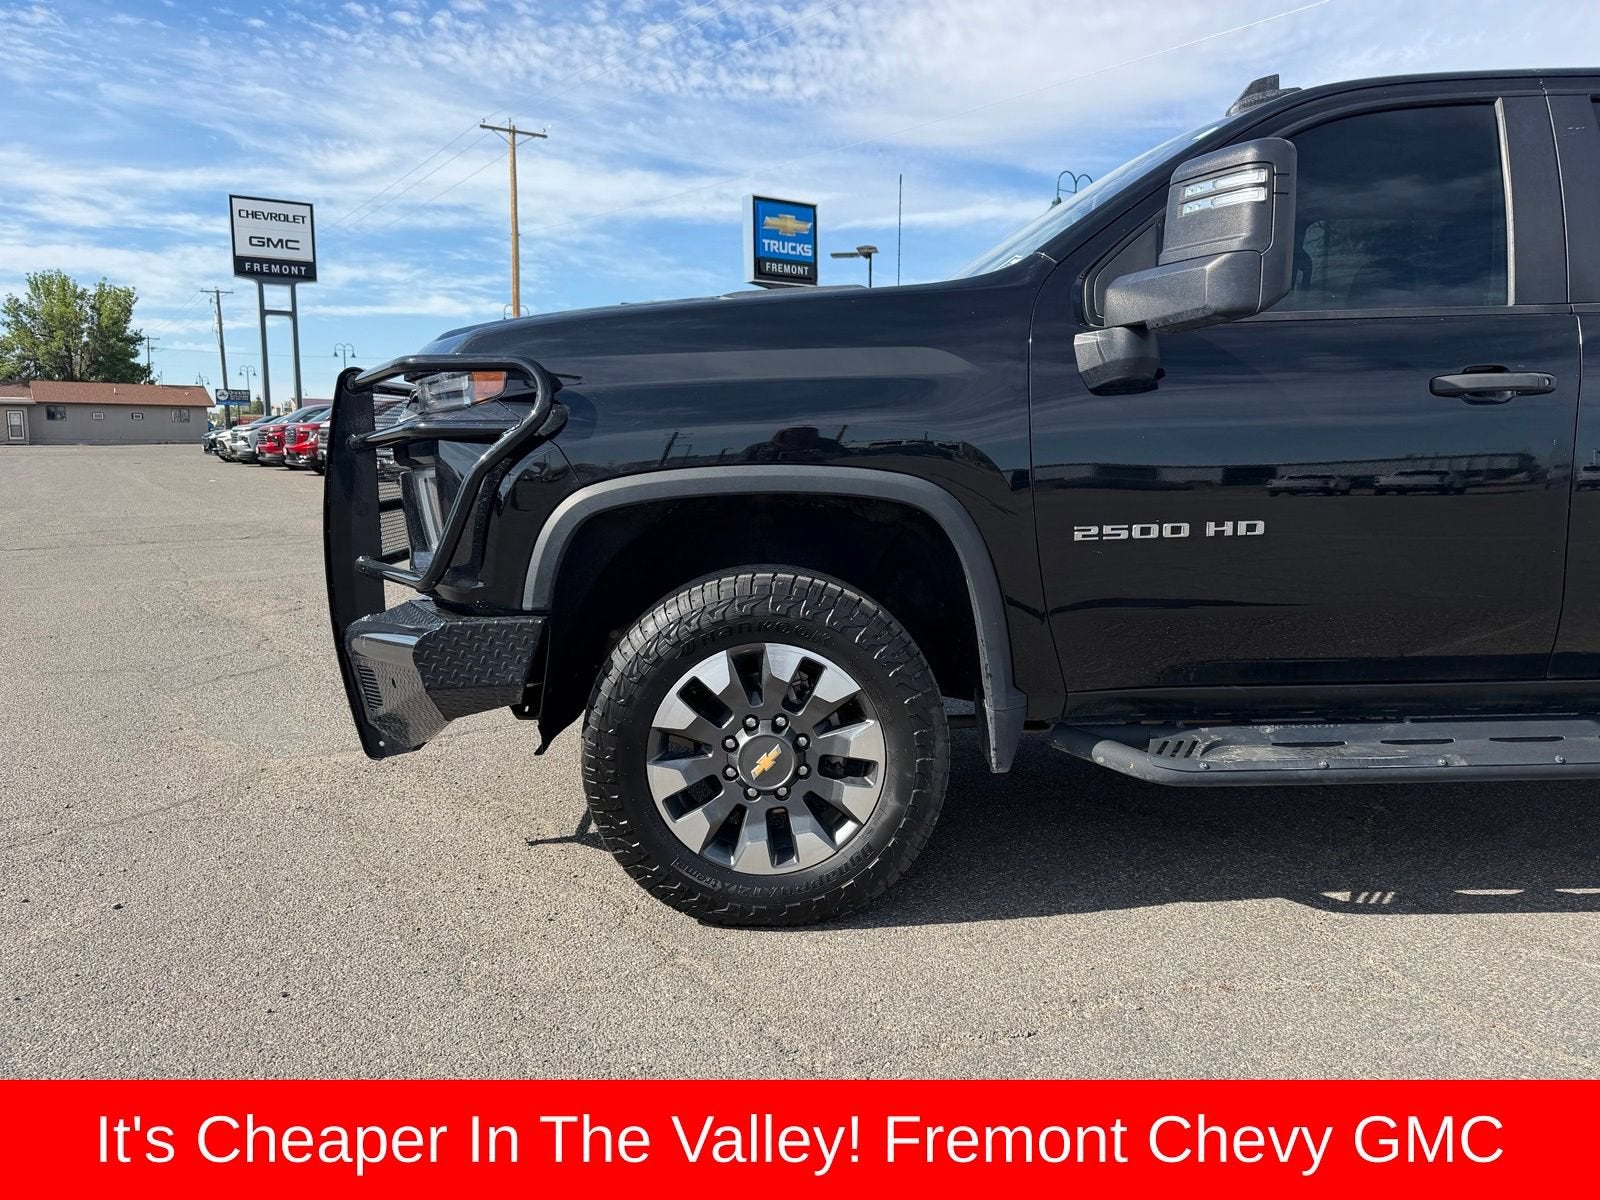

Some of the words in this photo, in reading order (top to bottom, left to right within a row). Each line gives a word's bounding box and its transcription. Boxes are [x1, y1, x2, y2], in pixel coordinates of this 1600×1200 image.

[238, 208, 307, 225] CHEVROLET
[248, 235, 301, 251] GMC
[762, 239, 812, 257] TRUCKS
[245, 262, 307, 276] FREMONT
[765, 262, 809, 276] FREMONT
[1073, 522, 1190, 542] 2500
[1206, 520, 1266, 537] HD
